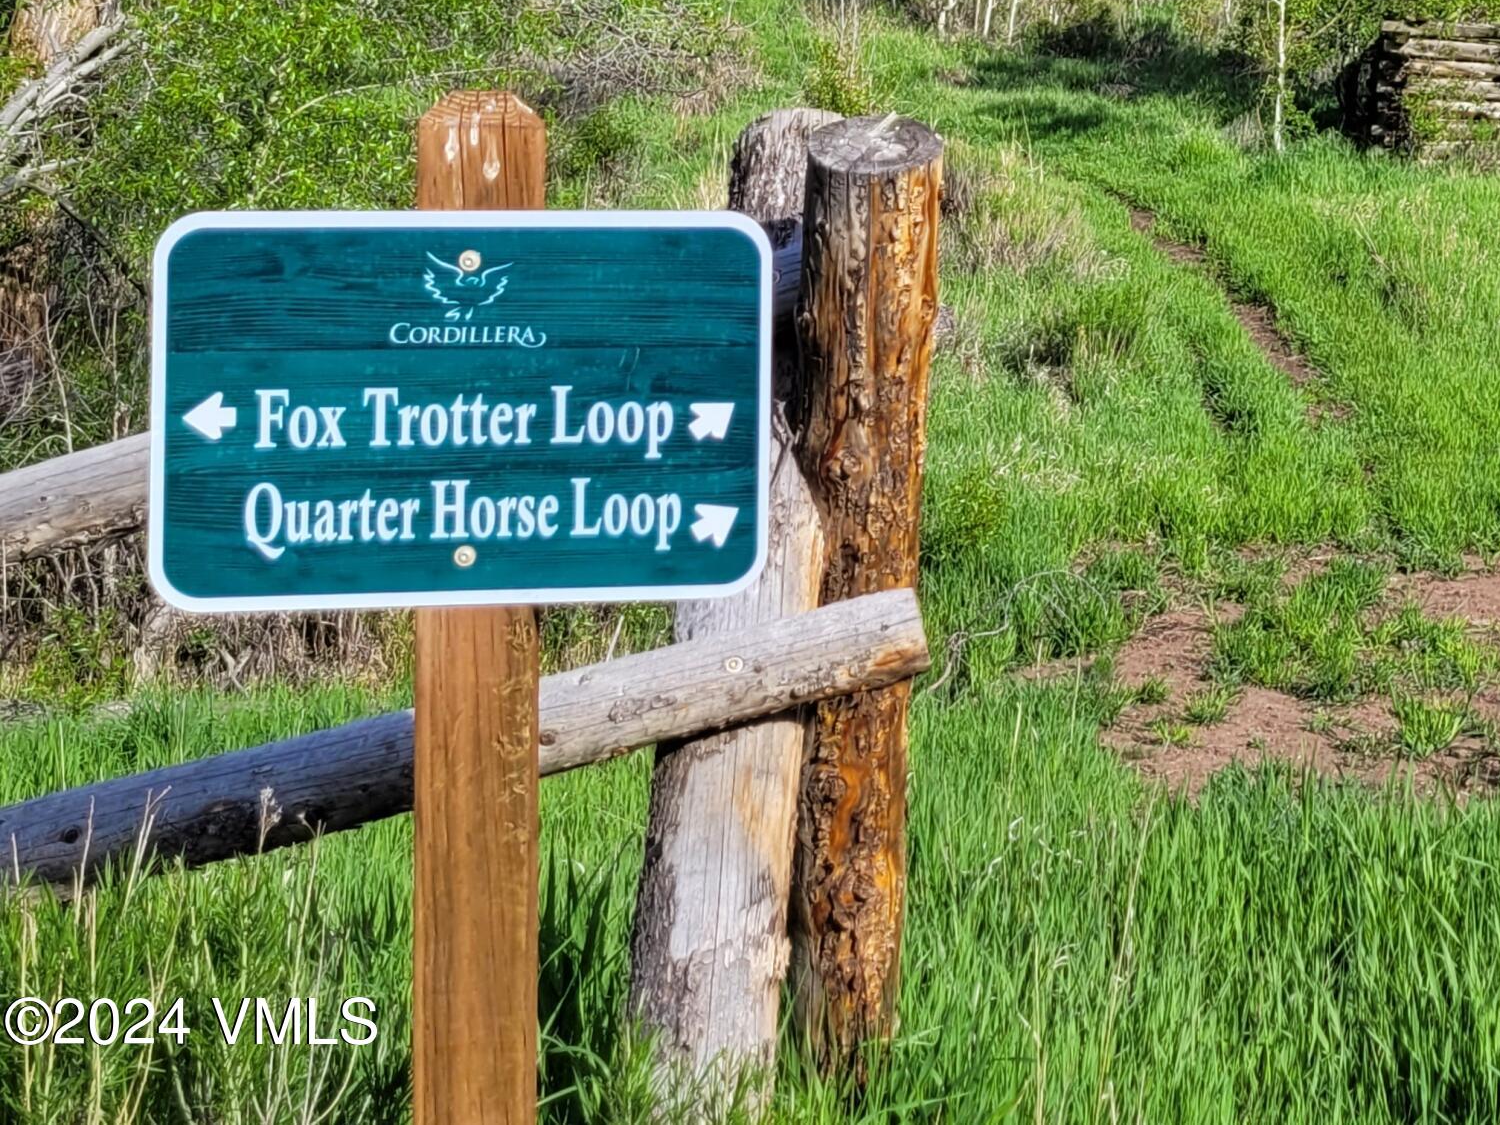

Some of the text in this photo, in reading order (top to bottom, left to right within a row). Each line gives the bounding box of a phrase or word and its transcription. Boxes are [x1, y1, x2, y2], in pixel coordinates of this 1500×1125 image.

[253, 384, 675, 459] Fox Trotter Loop
[243, 476, 682, 560] Quarter Horse Loop
